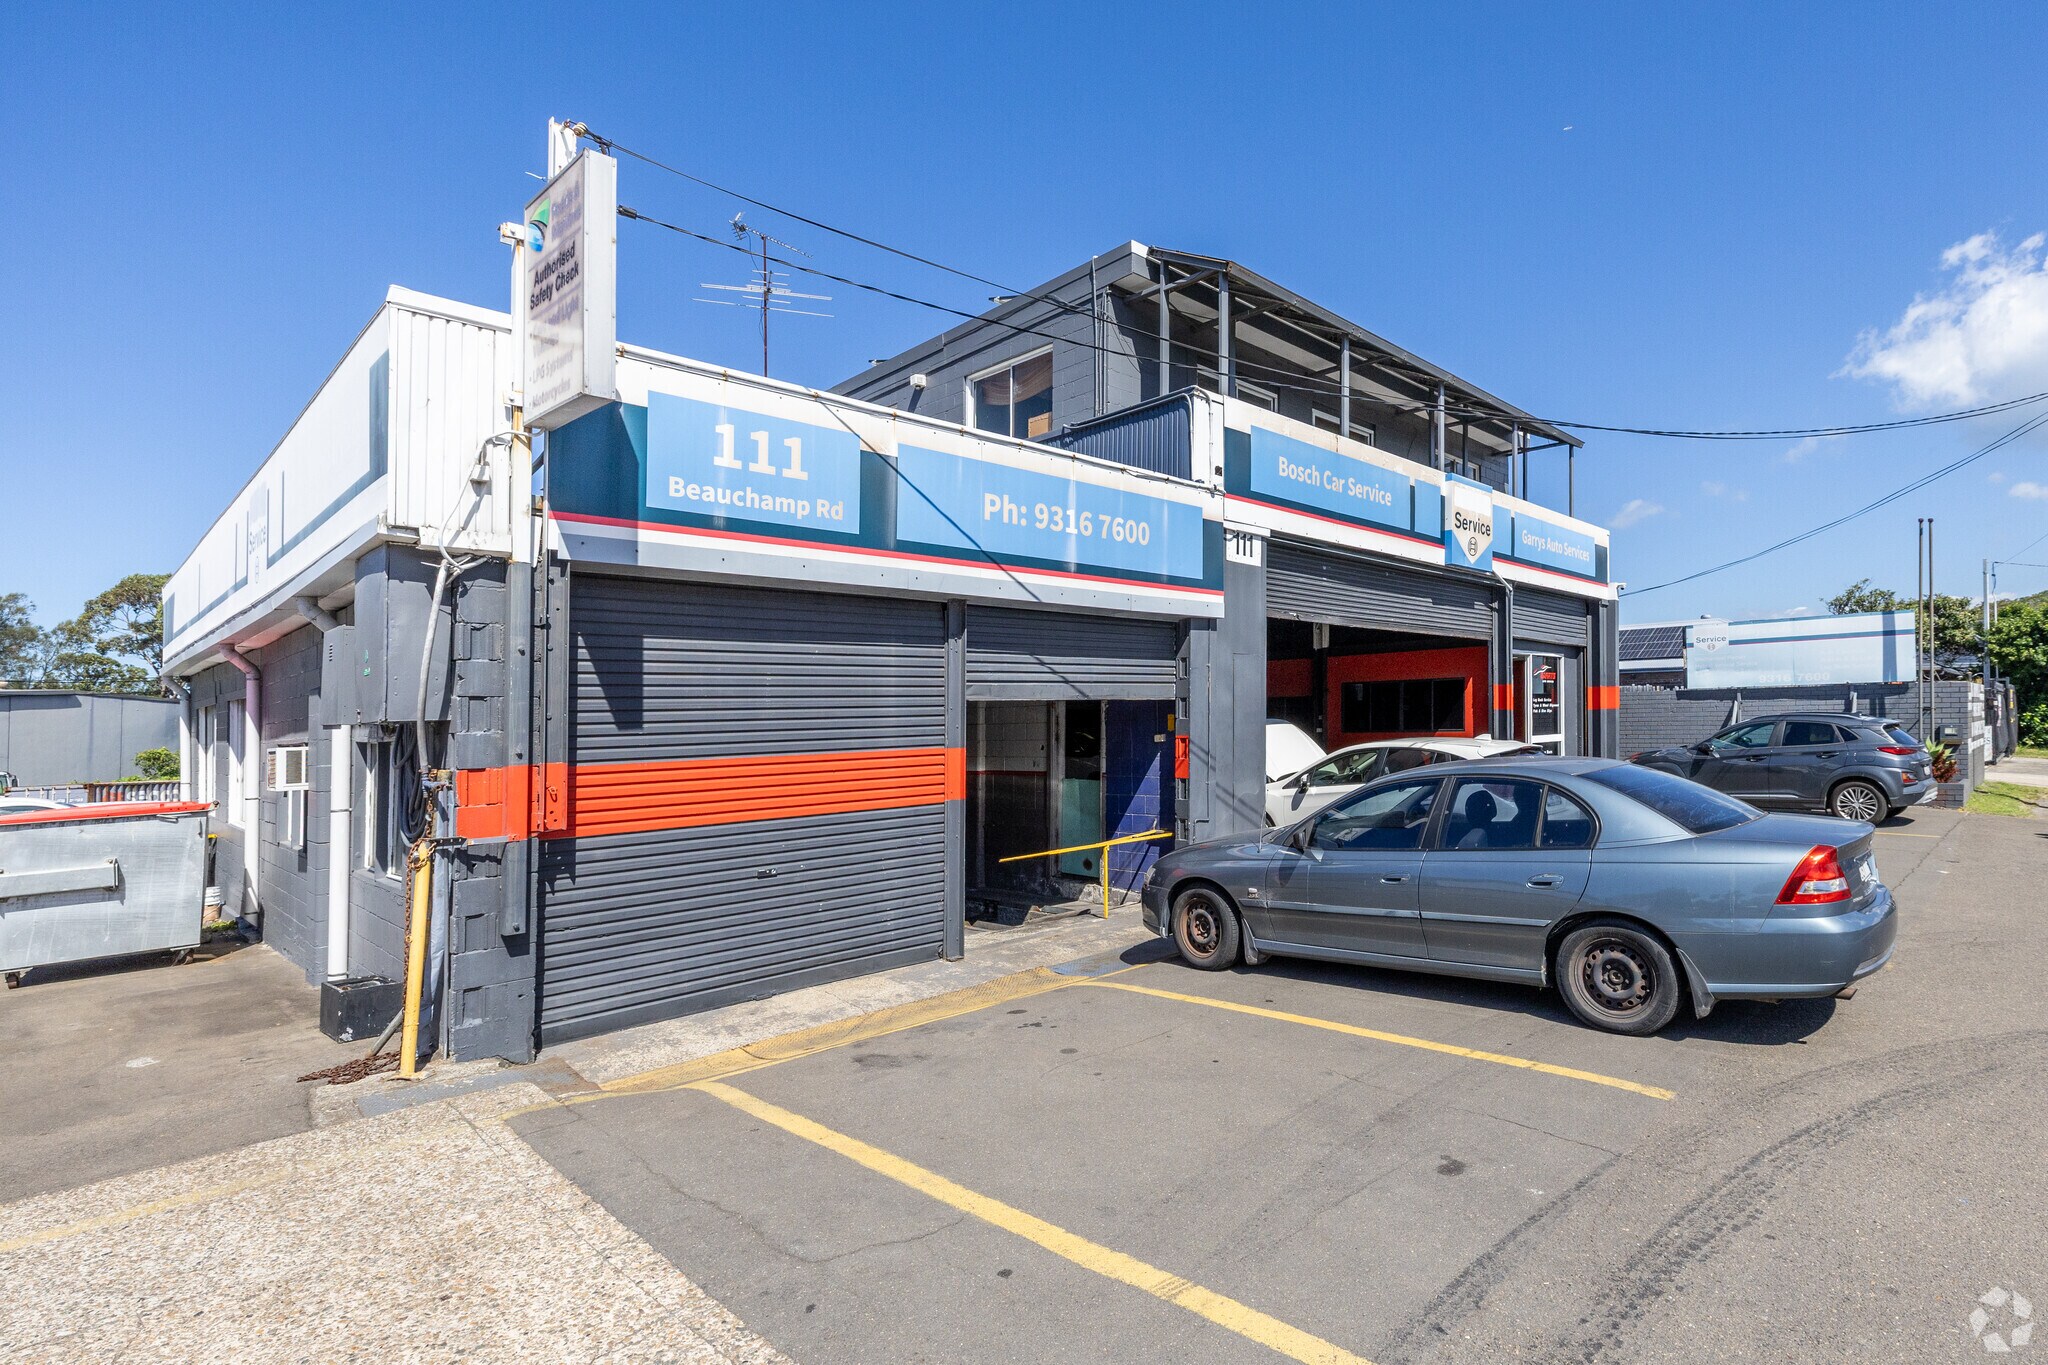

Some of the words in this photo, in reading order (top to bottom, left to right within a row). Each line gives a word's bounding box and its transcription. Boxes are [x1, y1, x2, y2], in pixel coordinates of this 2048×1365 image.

[530, 283, 553, 310] Safety
[555, 261, 579, 291] Check
[534, 240, 575, 288] Authorised
[713, 423, 808, 481] 111
[669, 475, 810, 519] Beauchamp
[816, 499, 844, 520] Rd
[1279, 456, 1320, 487] Bosch
[1323, 470, 1345, 493] Car
[1348, 477, 1392, 506] Service
[984, 492, 1027, 527] Ph:
[1034, 503, 1093, 537] 9316
[1098, 514, 1150, 546] 7600
[1454, 511, 1491, 537] Service
[1232, 530, 1253, 558] 111
[1521, 529, 1546, 552] Garrys
[1547, 537, 1563, 554] Auto
[1563, 541, 1590, 562] Services
[1695, 635, 1727, 644] Service
[1759, 673, 1791, 684] 9316
[1798, 671, 1831, 682] 7600
